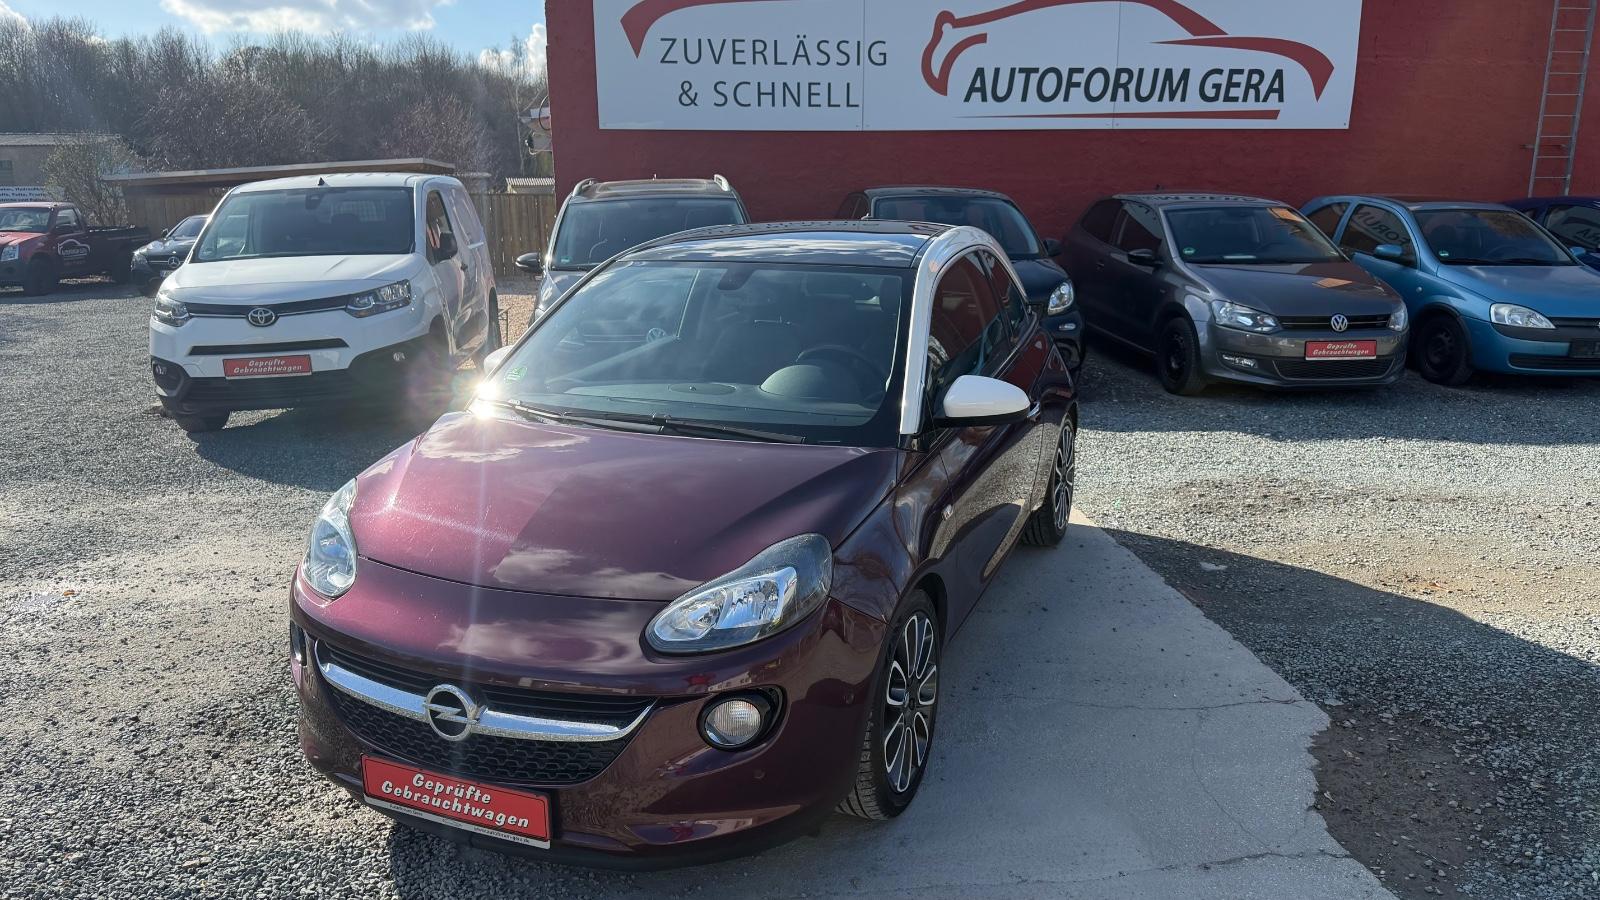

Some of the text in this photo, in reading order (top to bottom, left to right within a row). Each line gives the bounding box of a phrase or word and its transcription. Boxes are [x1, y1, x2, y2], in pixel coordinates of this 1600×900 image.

[659, 34, 887, 67] ZUVERLÄSSIG
[678, 80, 860, 108] & SCHNELL
[963, 66, 1285, 104] AUTOFORUM GERA
[233, 365, 302, 374] Gebrauchtwagen
[248, 358, 286, 368] Geprüfte
[381, 780, 529, 827] Gebrauchtwagen
[412, 773, 492, 805] Geprüfte
